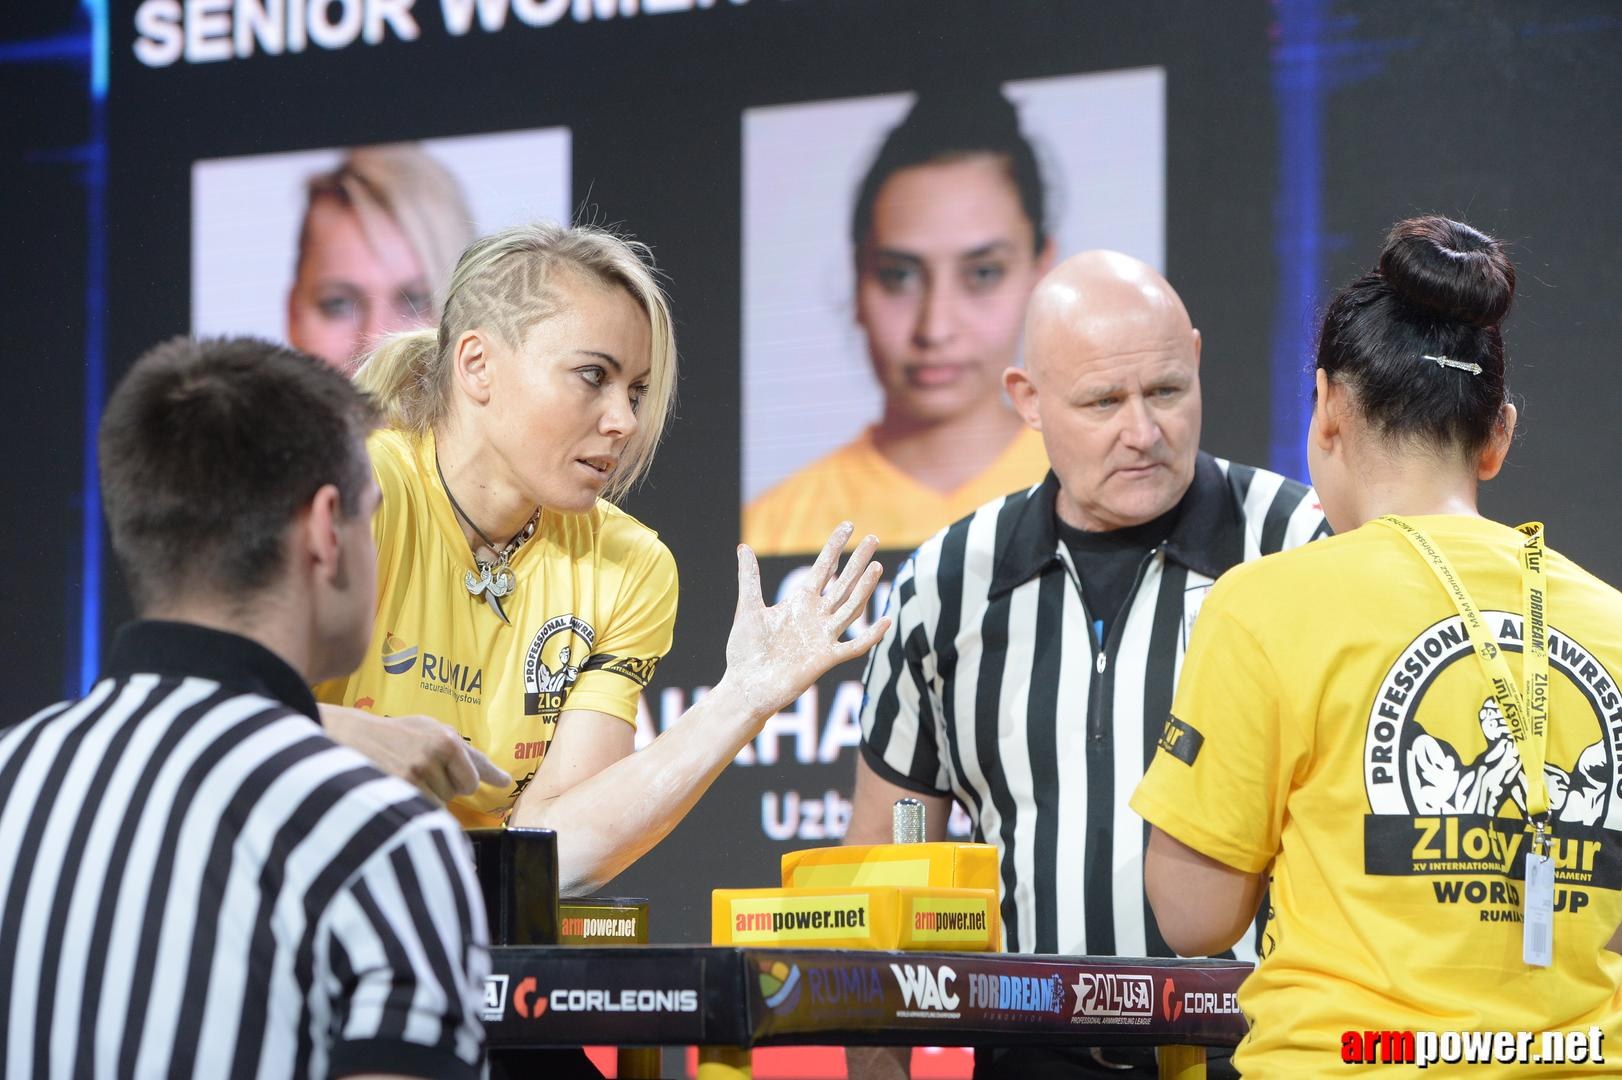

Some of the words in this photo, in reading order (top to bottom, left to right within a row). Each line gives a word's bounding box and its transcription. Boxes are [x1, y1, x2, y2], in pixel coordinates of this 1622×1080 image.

[421, 652, 482, 695] RUMIA
[1371, 622, 1470, 785] PROFESSION
[1412, 815, 1523, 873] Zloty
[1433, 881, 1520, 907] WORLD
[561, 916, 637, 938] armpower.net
[735, 906, 866, 932] armpower.net
[914, 909, 987, 933] armpower.net
[550, 989, 699, 1013] CORLEONIS
[807, 967, 885, 1004] RUMIA
[888, 963, 961, 1012] WAC
[968, 973, 1056, 1013] FORDREAM
[1184, 992, 1243, 1014] CORLEO
